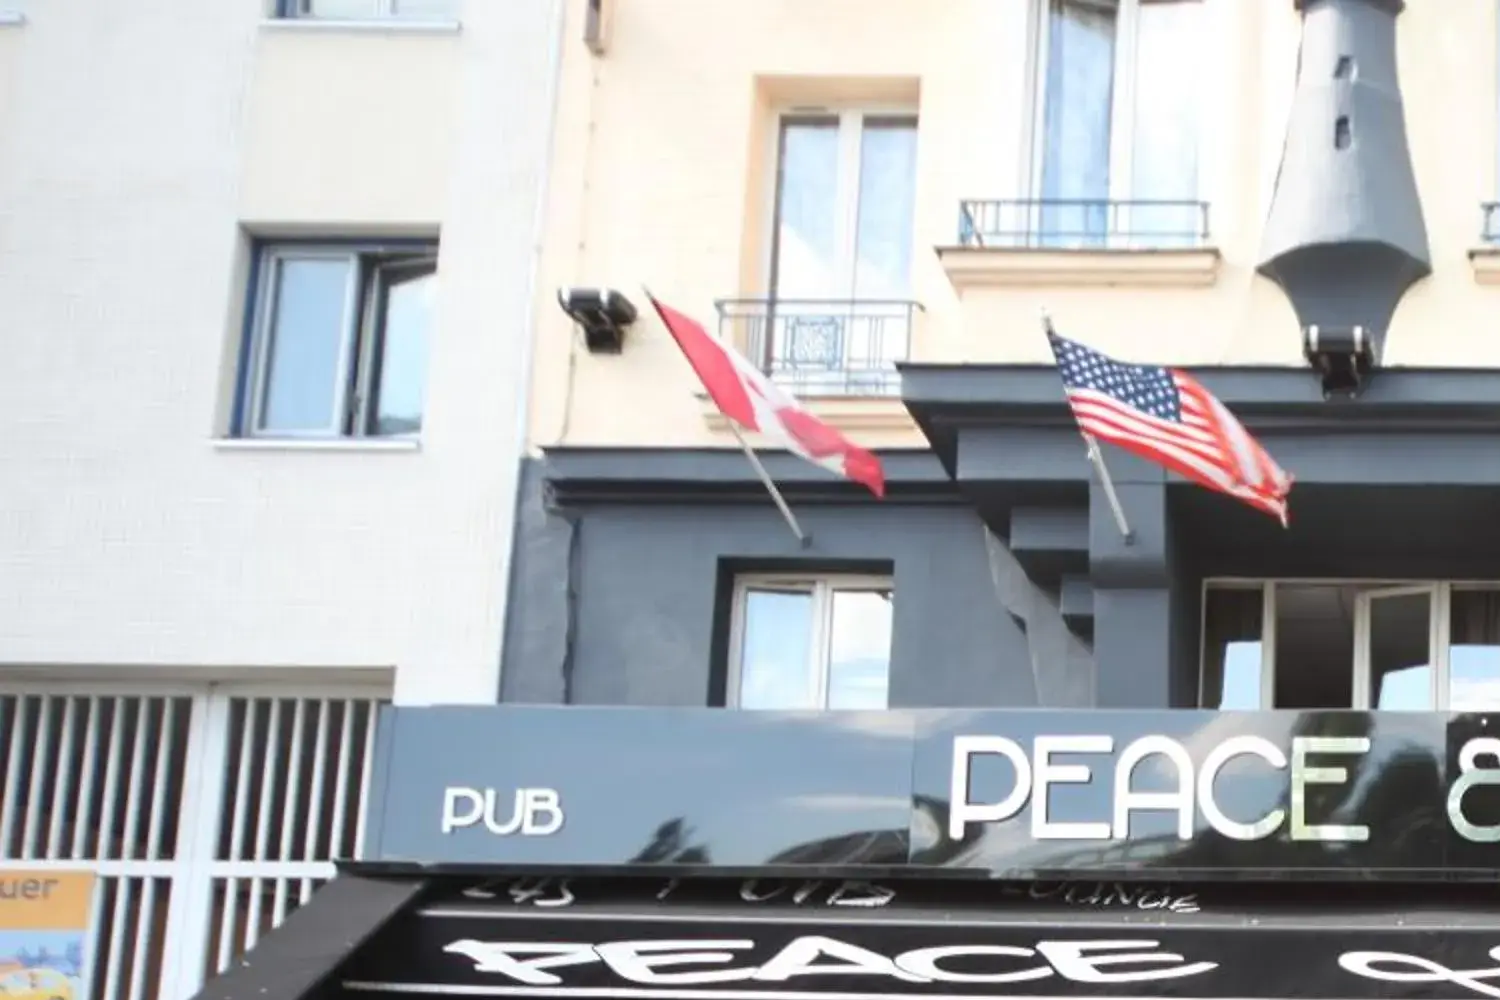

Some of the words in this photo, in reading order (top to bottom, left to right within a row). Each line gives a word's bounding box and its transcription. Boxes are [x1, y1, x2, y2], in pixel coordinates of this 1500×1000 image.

[442, 786, 564, 836] PUB
[948, 733, 1371, 842] PEACE
[443, 936, 1219, 984] PEACE
